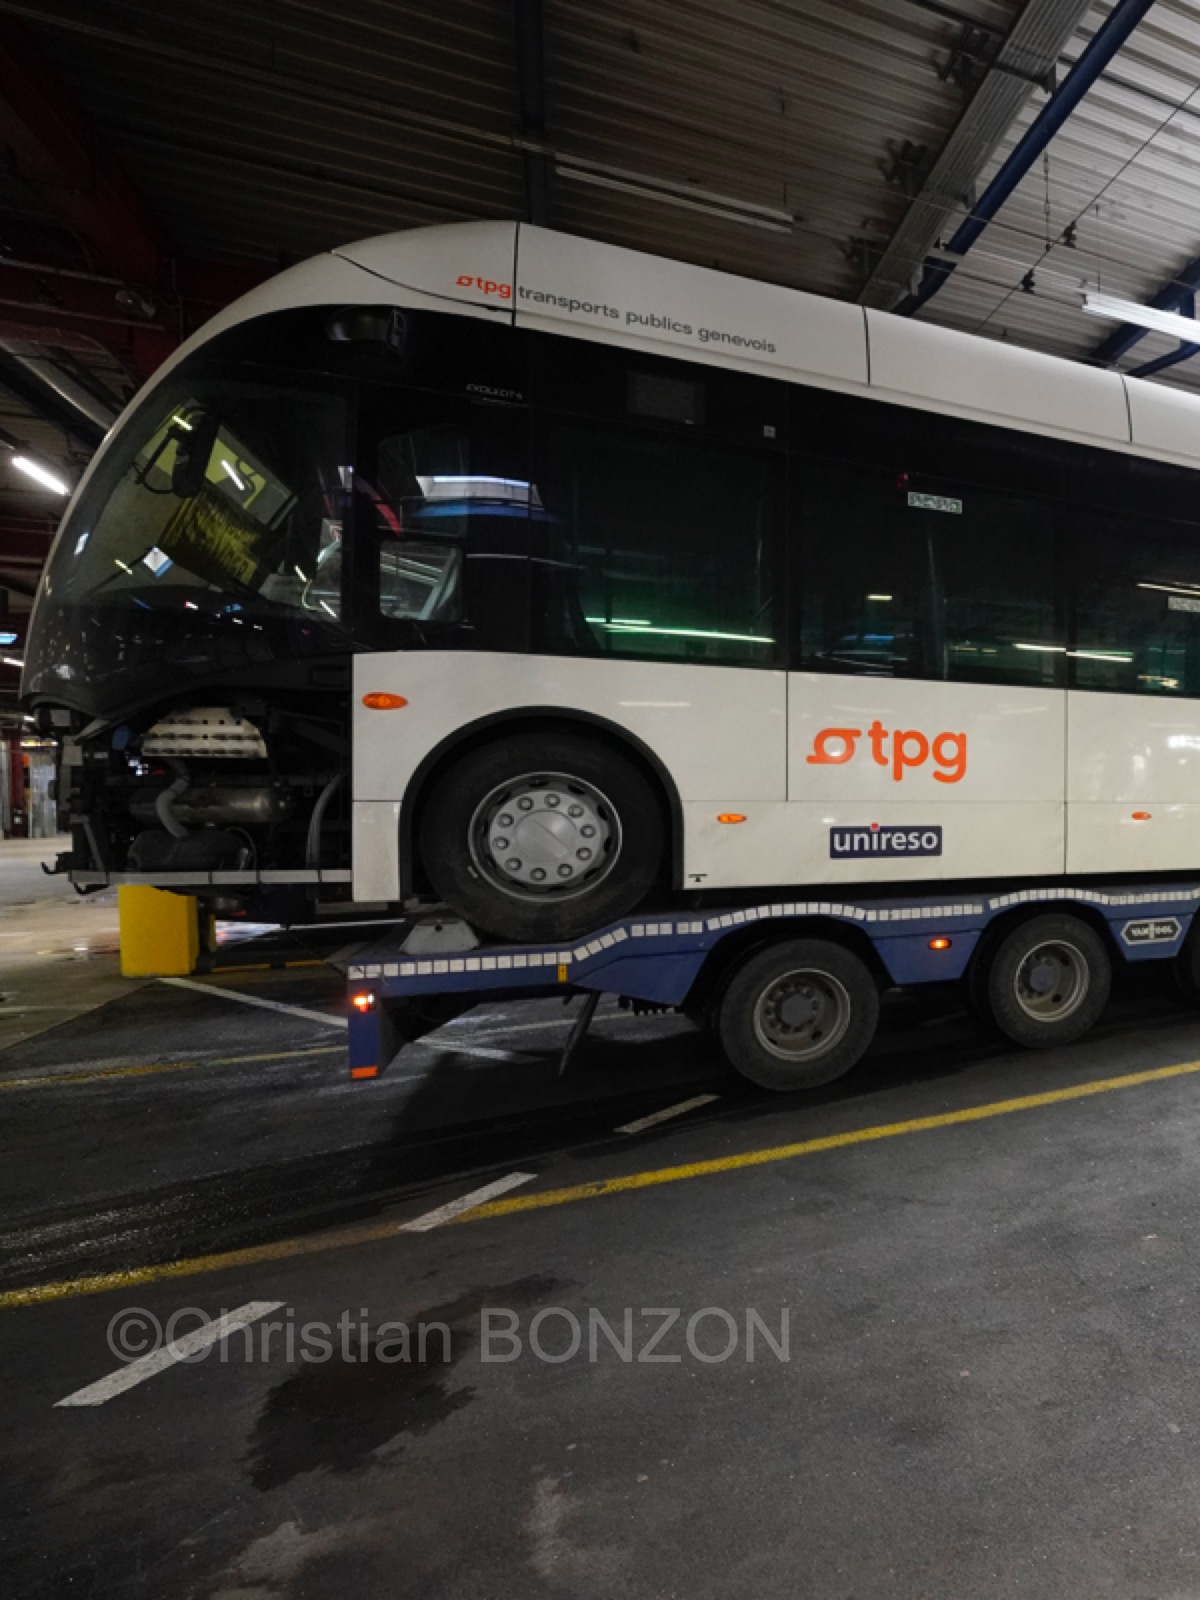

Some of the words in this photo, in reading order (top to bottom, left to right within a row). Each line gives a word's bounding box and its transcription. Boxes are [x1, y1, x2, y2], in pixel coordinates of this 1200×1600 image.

[476, 276, 511, 298] tpg
[518, 285, 620, 319] transports
[626, 310, 693, 335] publics
[698, 326, 777, 353] genevois
[868, 720, 967, 784] tpg
[833, 822, 939, 852] unireso
